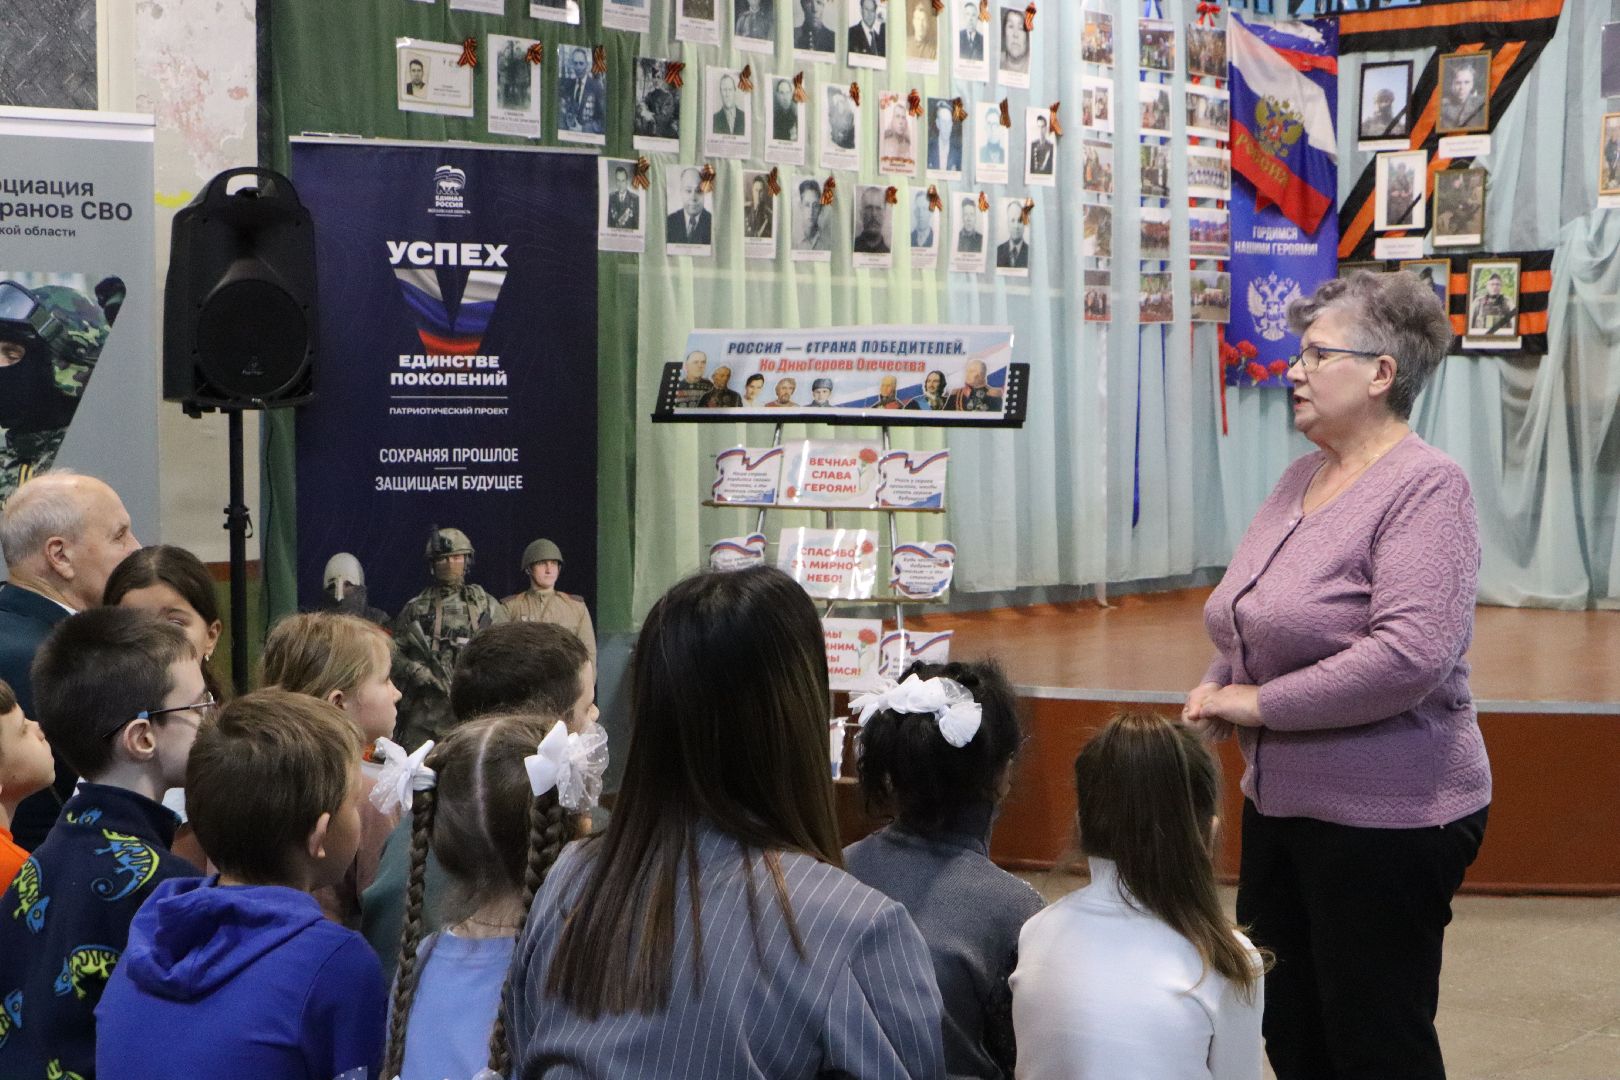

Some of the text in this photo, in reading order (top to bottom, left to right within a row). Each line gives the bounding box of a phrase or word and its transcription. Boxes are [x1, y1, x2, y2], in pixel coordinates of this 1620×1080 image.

[0, 178, 94, 198] циация
[81, 200, 133, 221] СВО
[24, 226, 76, 238] области
[1252, 226, 1298, 241] ГОРДИМСЯ
[386, 240, 509, 267] УСПЕХ
[1234, 240, 1271, 255] НАШИМИ
[728, 341, 783, 354] РОССИЯ
[806, 340, 857, 353] СТРАНА
[861, 339, 967, 356] ПОБЕДИТЕЛЕЙ.
[399, 354, 500, 369] ЕДИНСТВЕ
[857, 358, 926, 372] Отечества
[390, 370, 508, 386] ПОКОЛЕНИЙ
[389, 406, 509, 415] ПАТРИОТИЧЕСКИЙ ПРОЕКТ
[379, 448, 519, 463] СОХРАНЯЯ ПРОШЛОЕ
[809, 457, 857, 467] ВЕЧНАЯ
[811, 470, 852, 480] СЛАВА
[375, 475, 523, 492] ЗАЩИЩАЕМ БУДУЩЕЕ
[804, 483, 857, 493] ГЕРОЯМ!
[806, 573, 843, 583] НЕБО!
